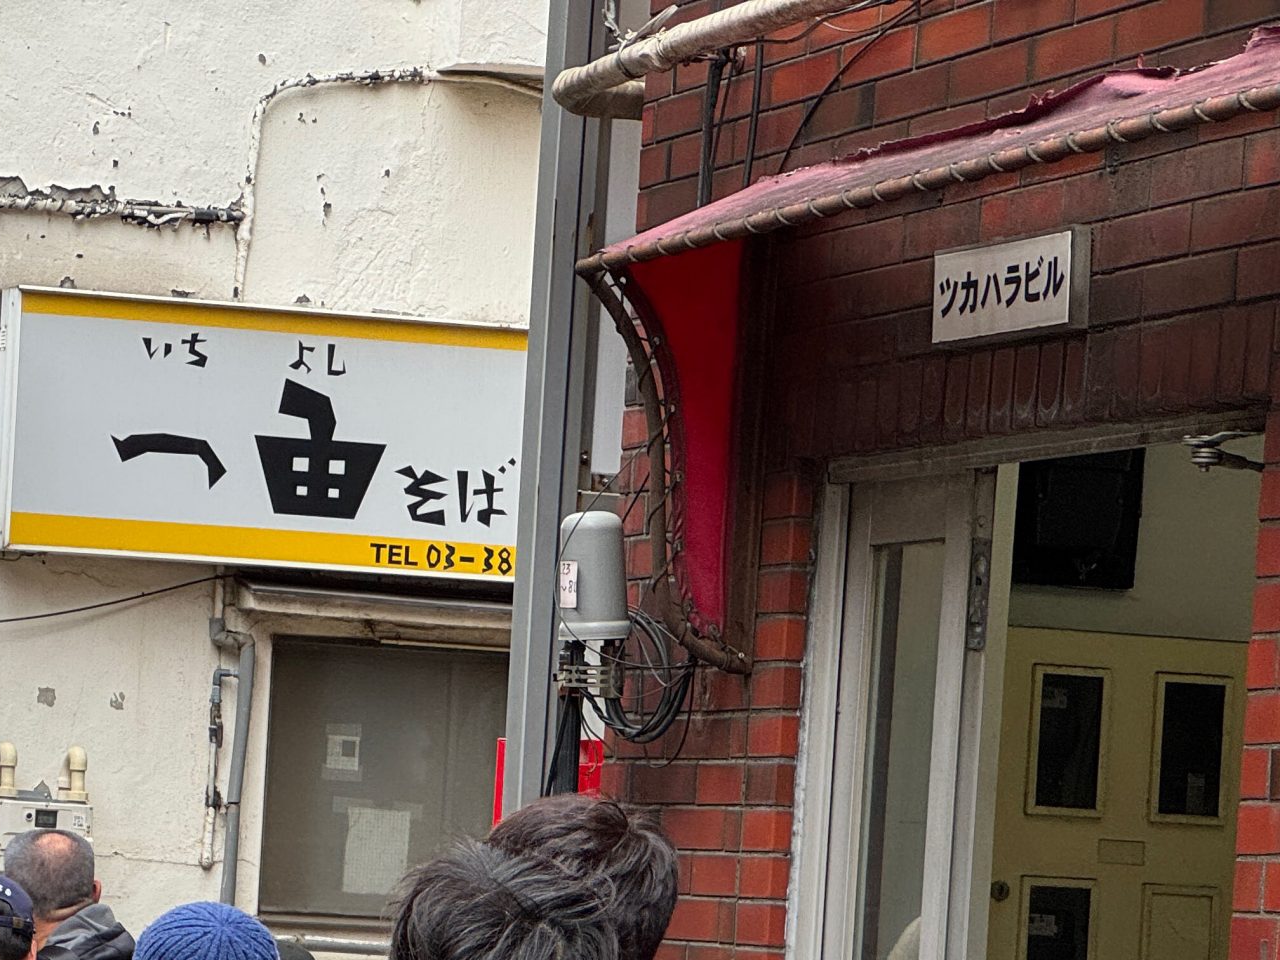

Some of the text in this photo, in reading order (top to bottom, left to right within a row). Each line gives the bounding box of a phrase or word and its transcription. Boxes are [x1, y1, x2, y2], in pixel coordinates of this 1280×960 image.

[939, 255, 1065, 318] ツカハラビル
[142, 332, 347, 376] いち よし
[370, 543, 418, 567] TEL
